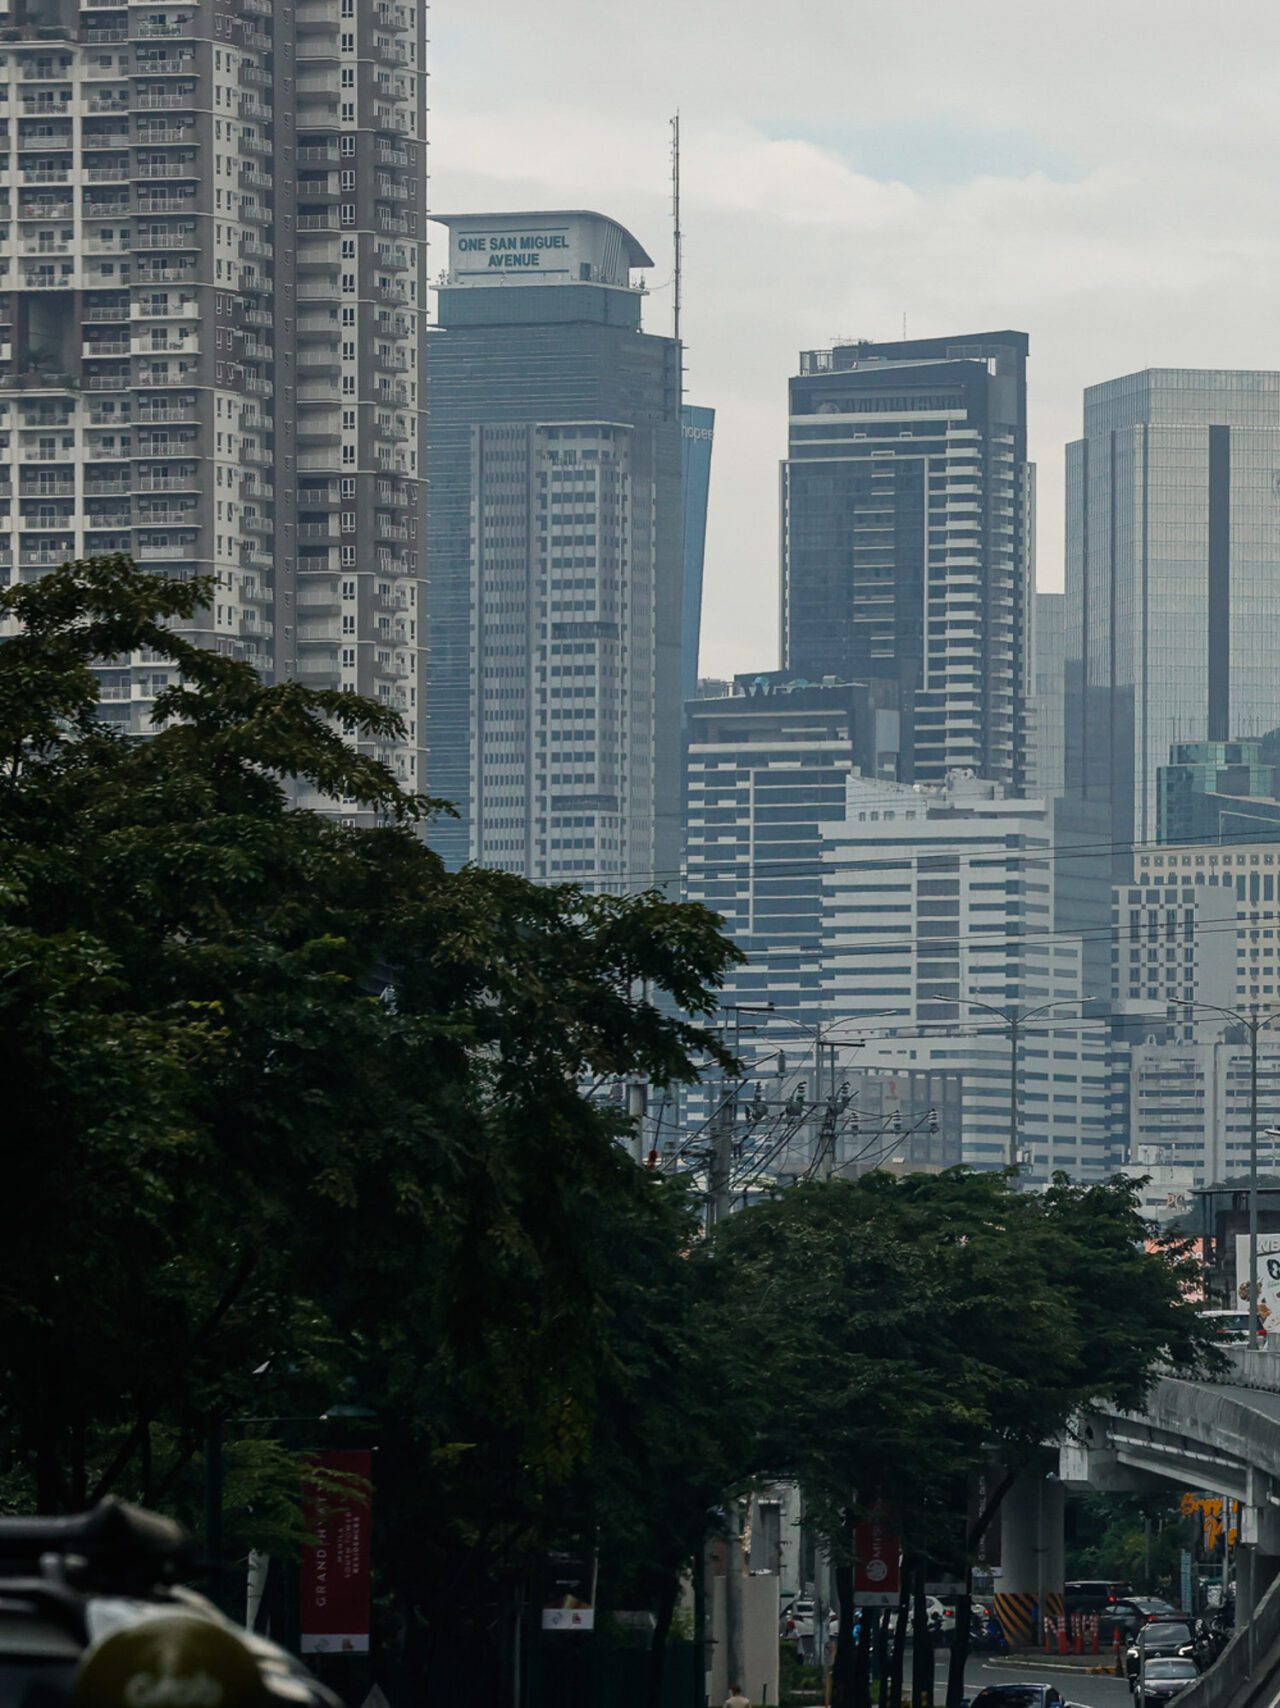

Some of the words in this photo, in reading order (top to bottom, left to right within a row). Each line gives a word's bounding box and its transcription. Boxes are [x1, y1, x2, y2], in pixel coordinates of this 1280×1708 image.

[458, 238, 487, 251] ONE
[490, 237, 517, 251] SAN
[520, 235, 569, 250] MIGUEL
[488, 253, 540, 267] AVENUE
[681, 423, 714, 443] hopee
[316, 1549, 327, 1607] GRAND
